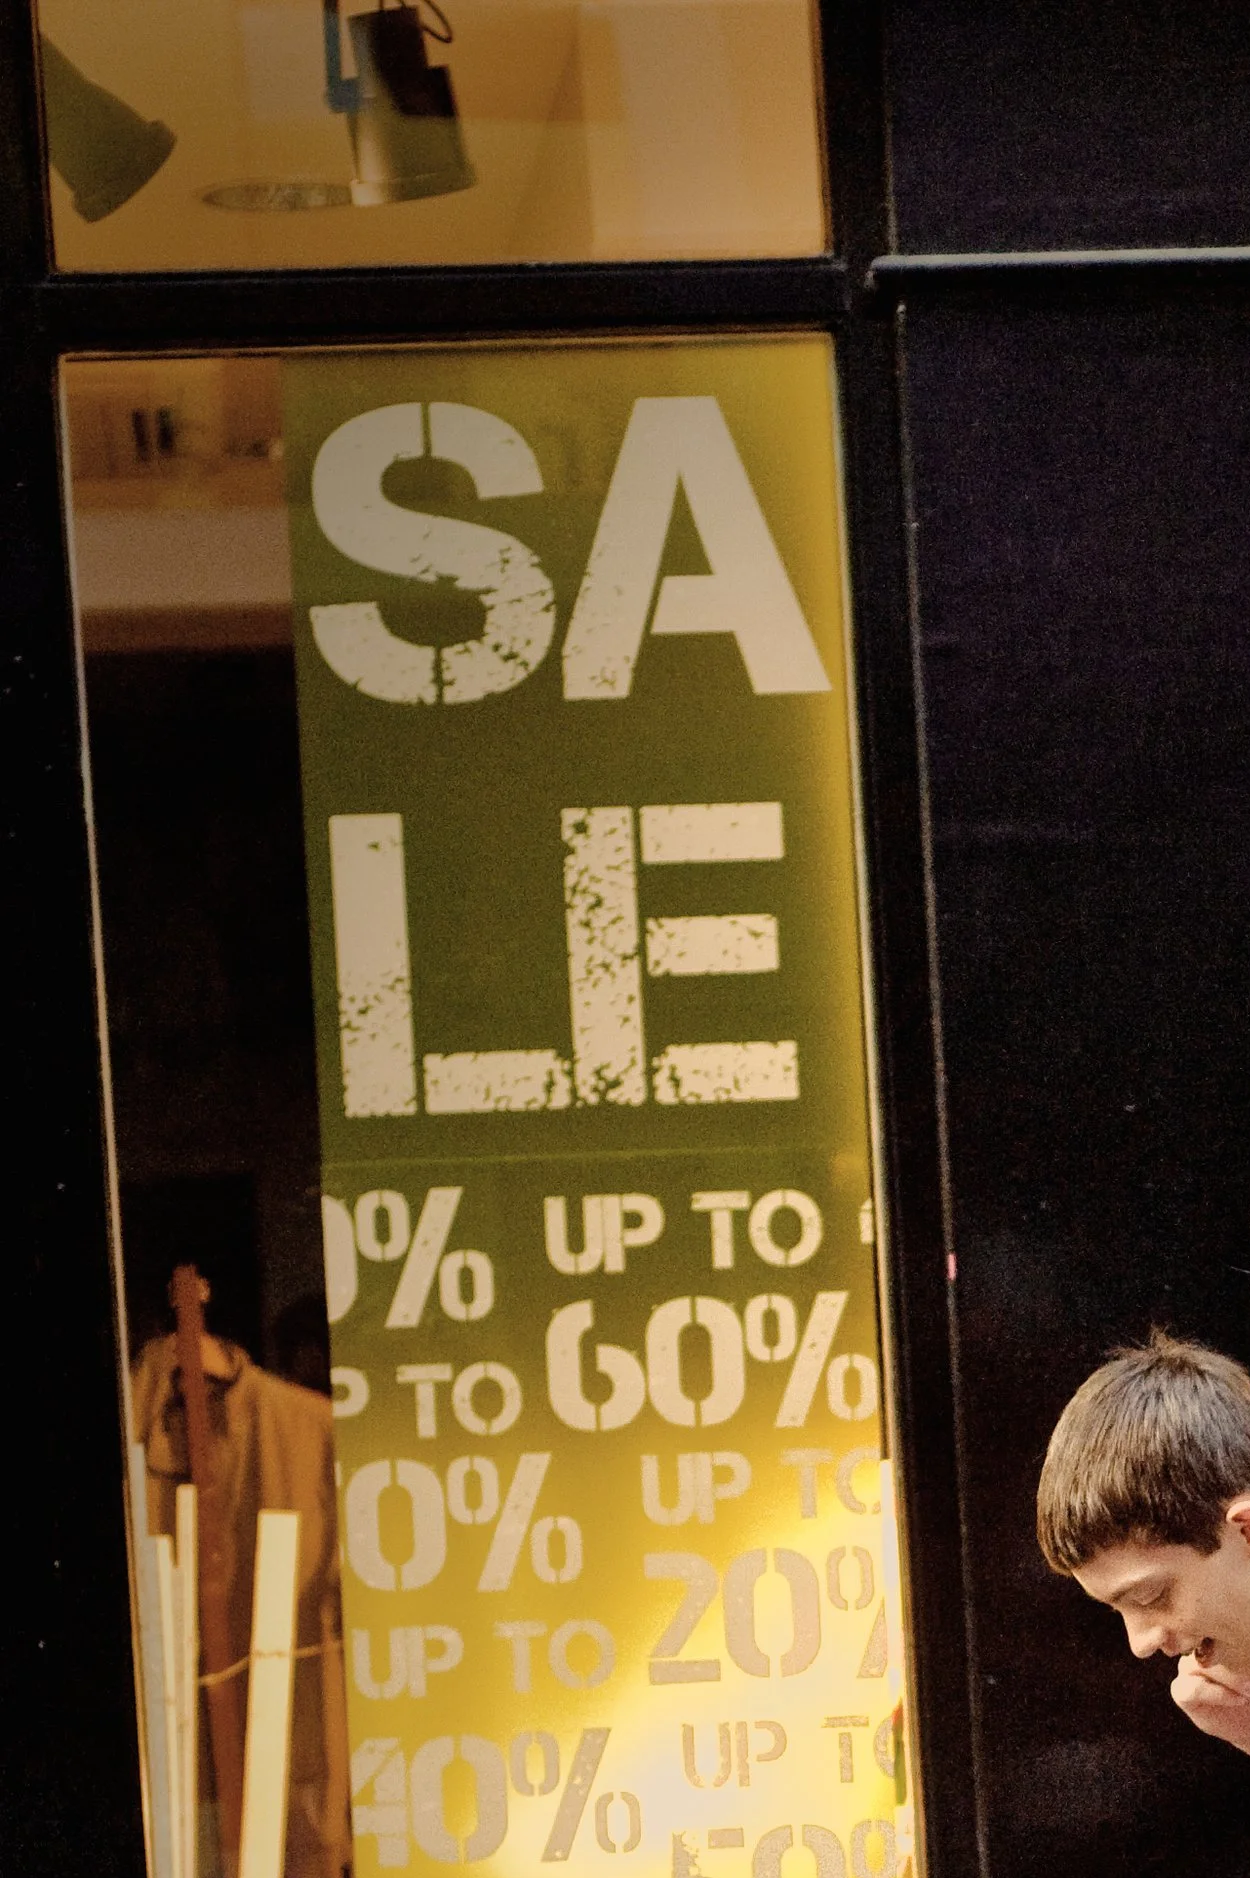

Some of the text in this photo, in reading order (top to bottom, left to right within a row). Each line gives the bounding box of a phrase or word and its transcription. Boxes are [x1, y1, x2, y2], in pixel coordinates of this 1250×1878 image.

[309, 396, 832, 706] SA
[329, 802, 799, 1118] LE
[544, 1193, 665, 1275] UP
[692, 1189, 824, 1270] TO
[396, 1361, 523, 1439] TO
[545, 1291, 877, 1431] 60%
[641, 1452, 751, 1526] UP
[352, 1619, 616, 1699] UP TO
[682, 1720, 787, 1787] UP
[351, 1727, 642, 1868] 40%
